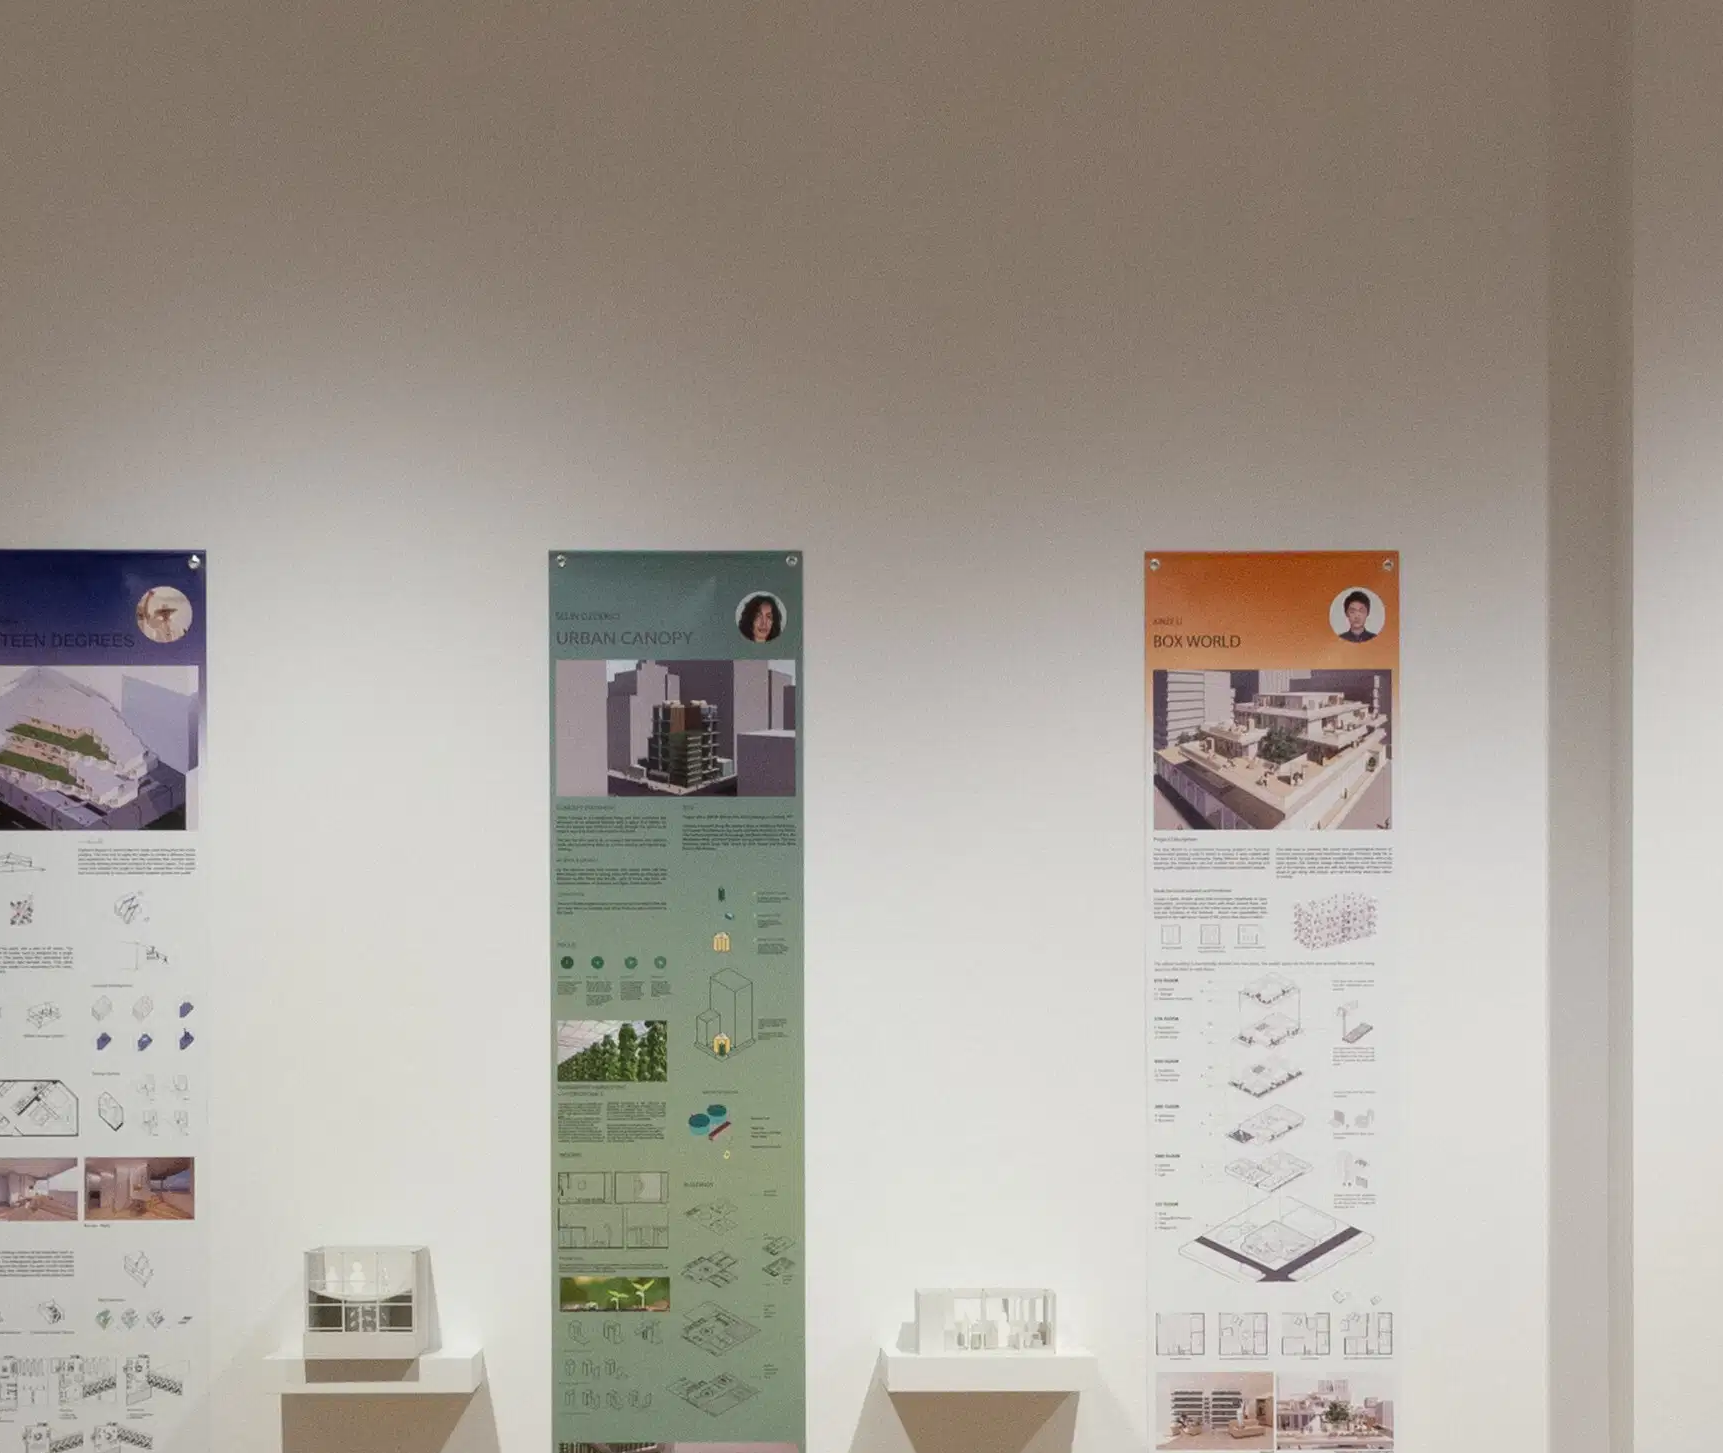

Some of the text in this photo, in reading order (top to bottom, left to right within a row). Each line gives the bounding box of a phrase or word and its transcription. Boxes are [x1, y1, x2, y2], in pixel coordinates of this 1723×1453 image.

[51, 633, 135, 648] DEGREES
[556, 631, 694, 645] URBAN CANOPY
[1153, 634, 1241, 649] BOX WORLD
